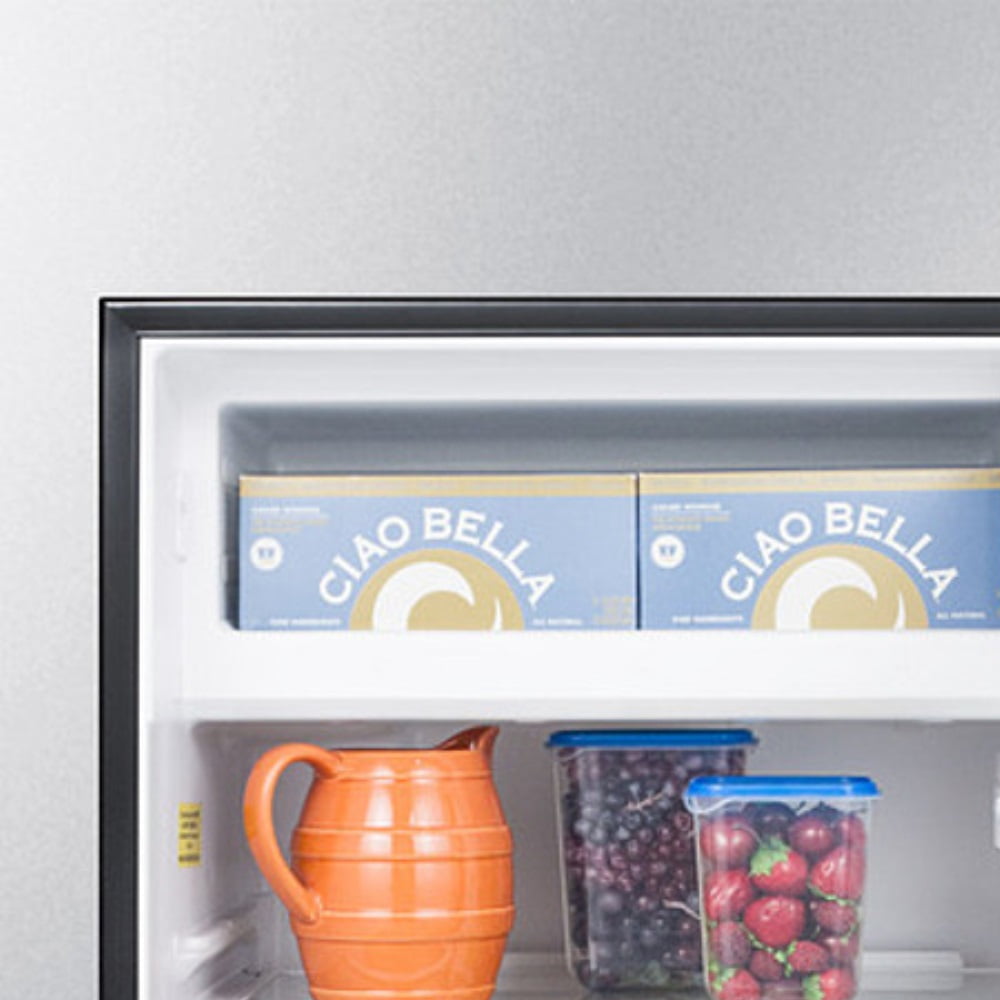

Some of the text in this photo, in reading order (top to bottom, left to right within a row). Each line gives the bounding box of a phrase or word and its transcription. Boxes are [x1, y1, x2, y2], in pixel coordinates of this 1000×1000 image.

[319, 506, 555, 608] CIAO BELLA
[721, 501, 959, 601] CIAO BELLA
